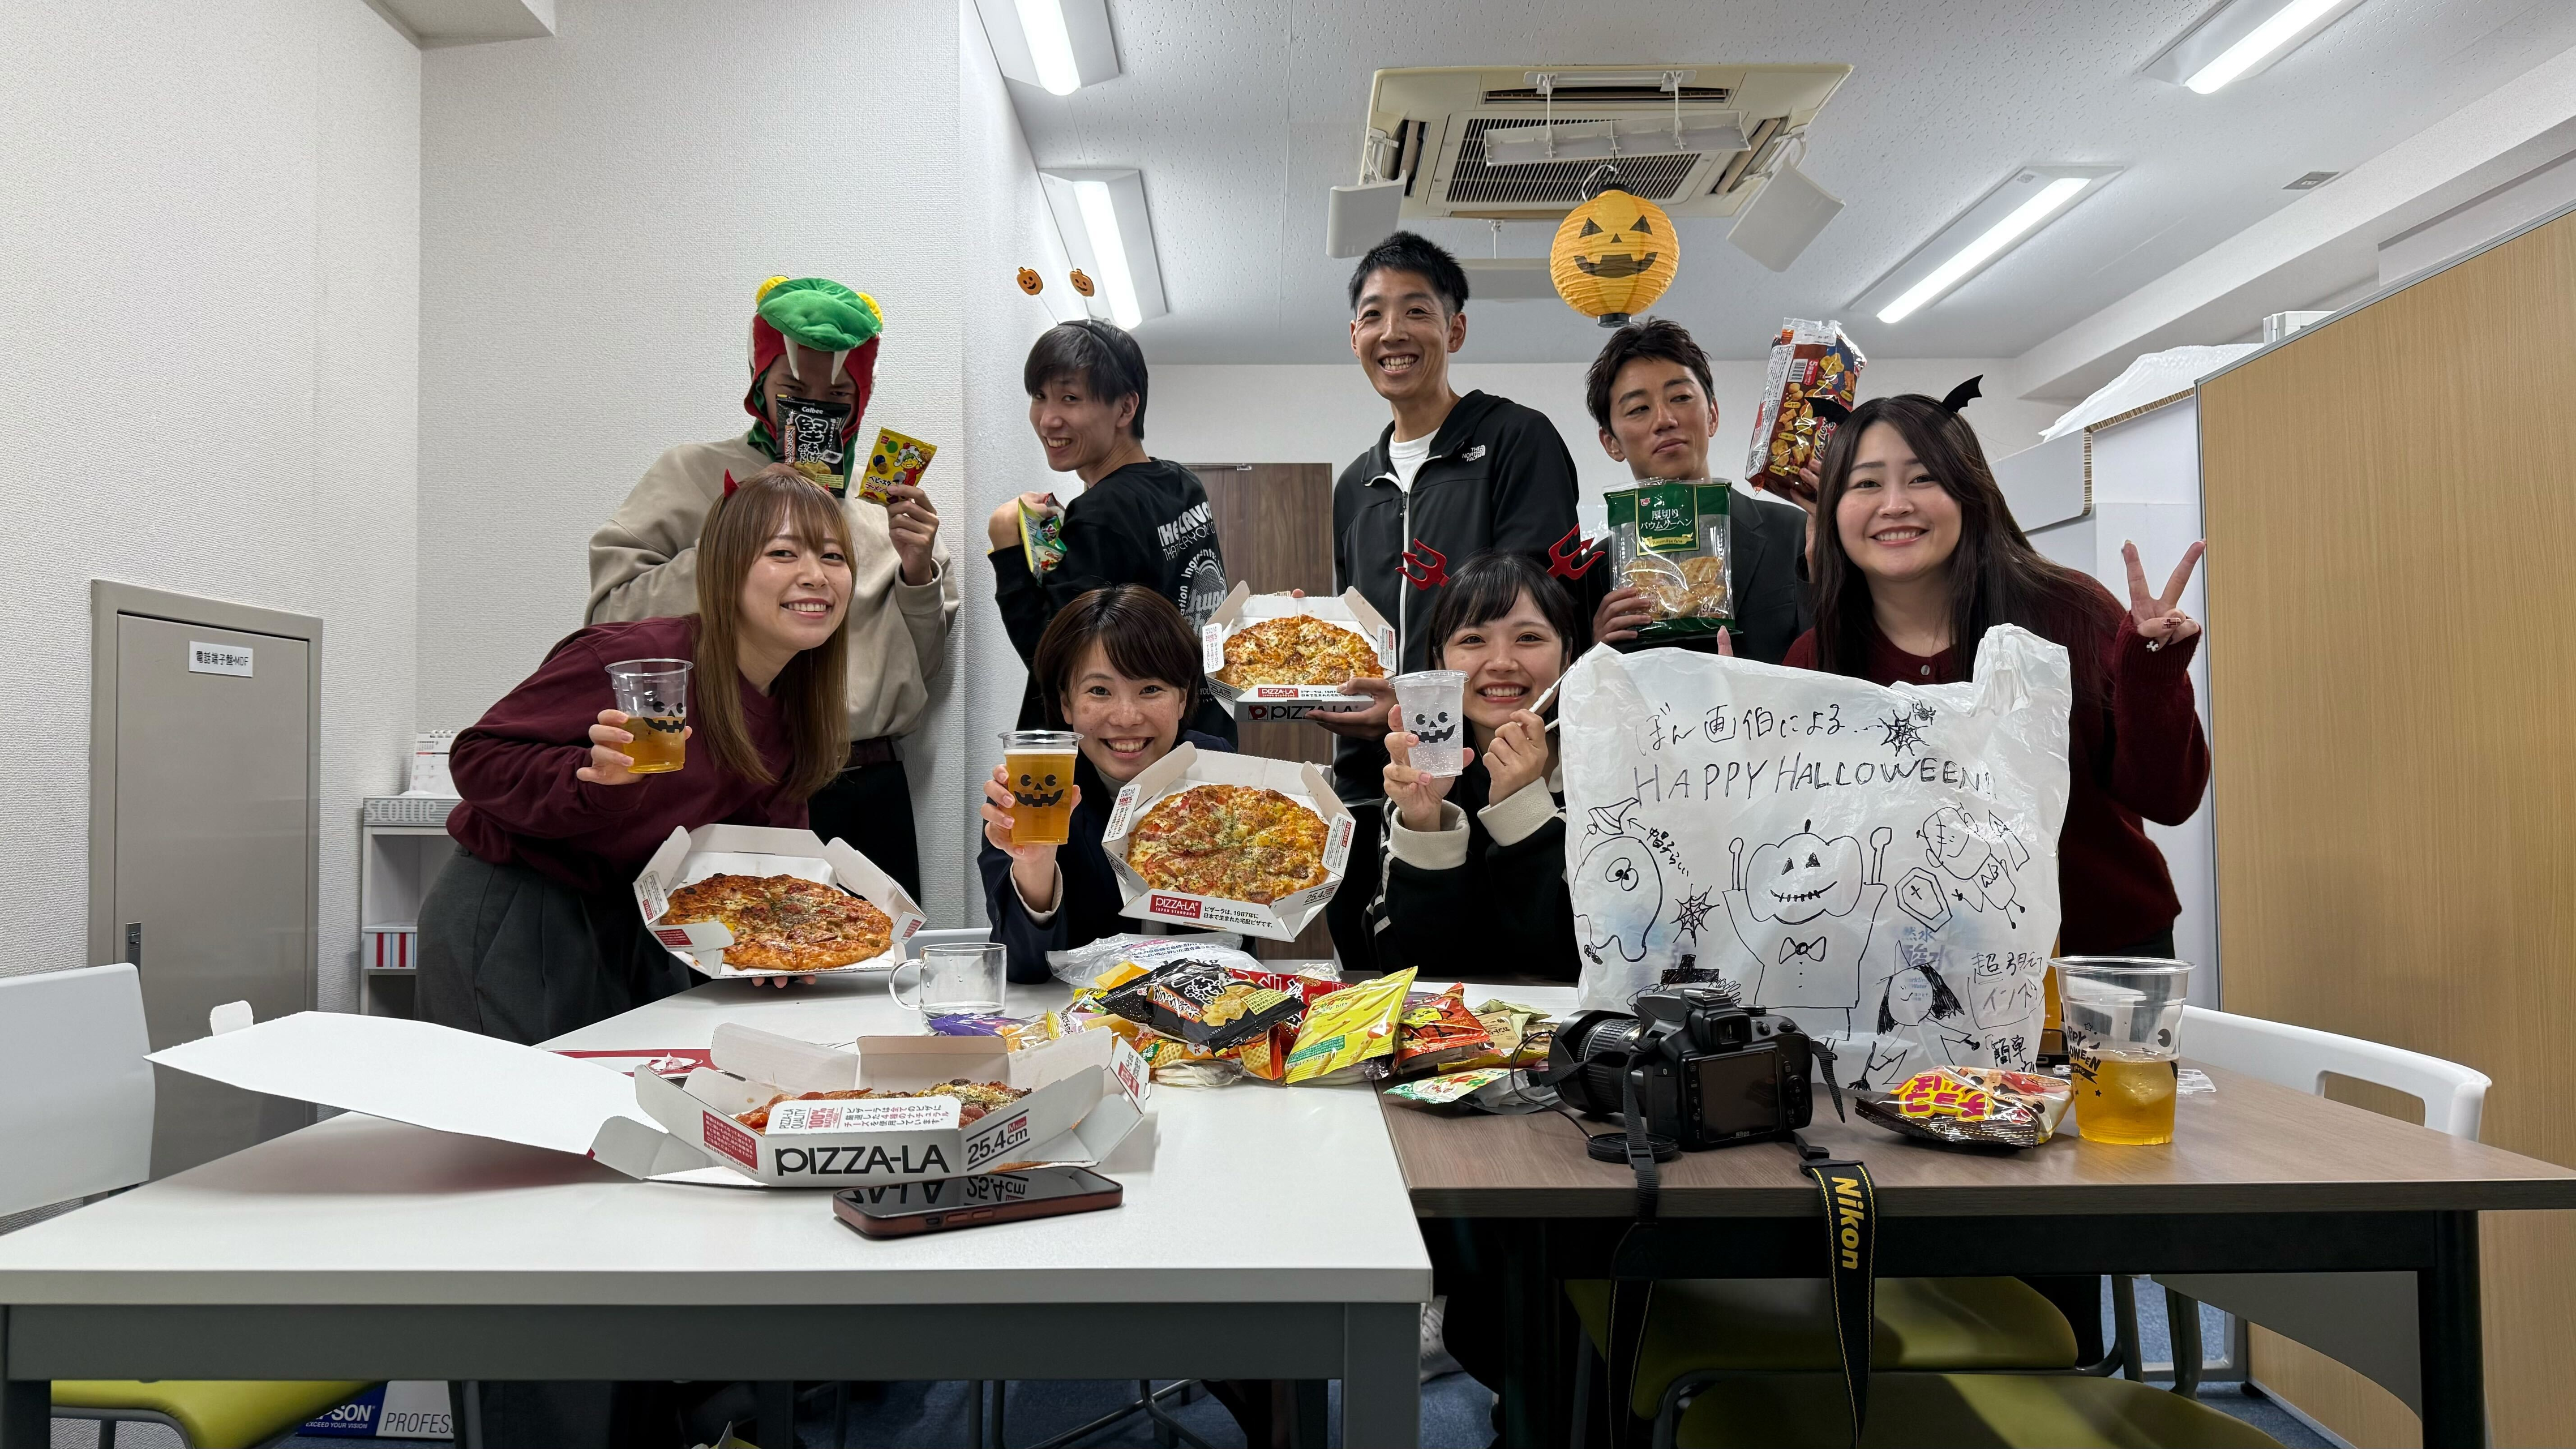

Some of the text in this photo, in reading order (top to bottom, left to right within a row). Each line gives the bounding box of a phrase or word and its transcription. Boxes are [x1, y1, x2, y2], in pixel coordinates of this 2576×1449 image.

[1652, 509, 1679, 521] 厚切り
[1634, 758, 1768, 809] HAPPY
[779, 1108, 794, 1129] PIZZA-LA
[790, 1108, 807, 1129] QUALITY
[808, 1107, 827, 1129] 100%
[967, 1127, 1028, 1166] 25.4cm
[775, 1144, 950, 1177] PIZZA-LA
[1831, 1176, 1865, 1270] Nikon
